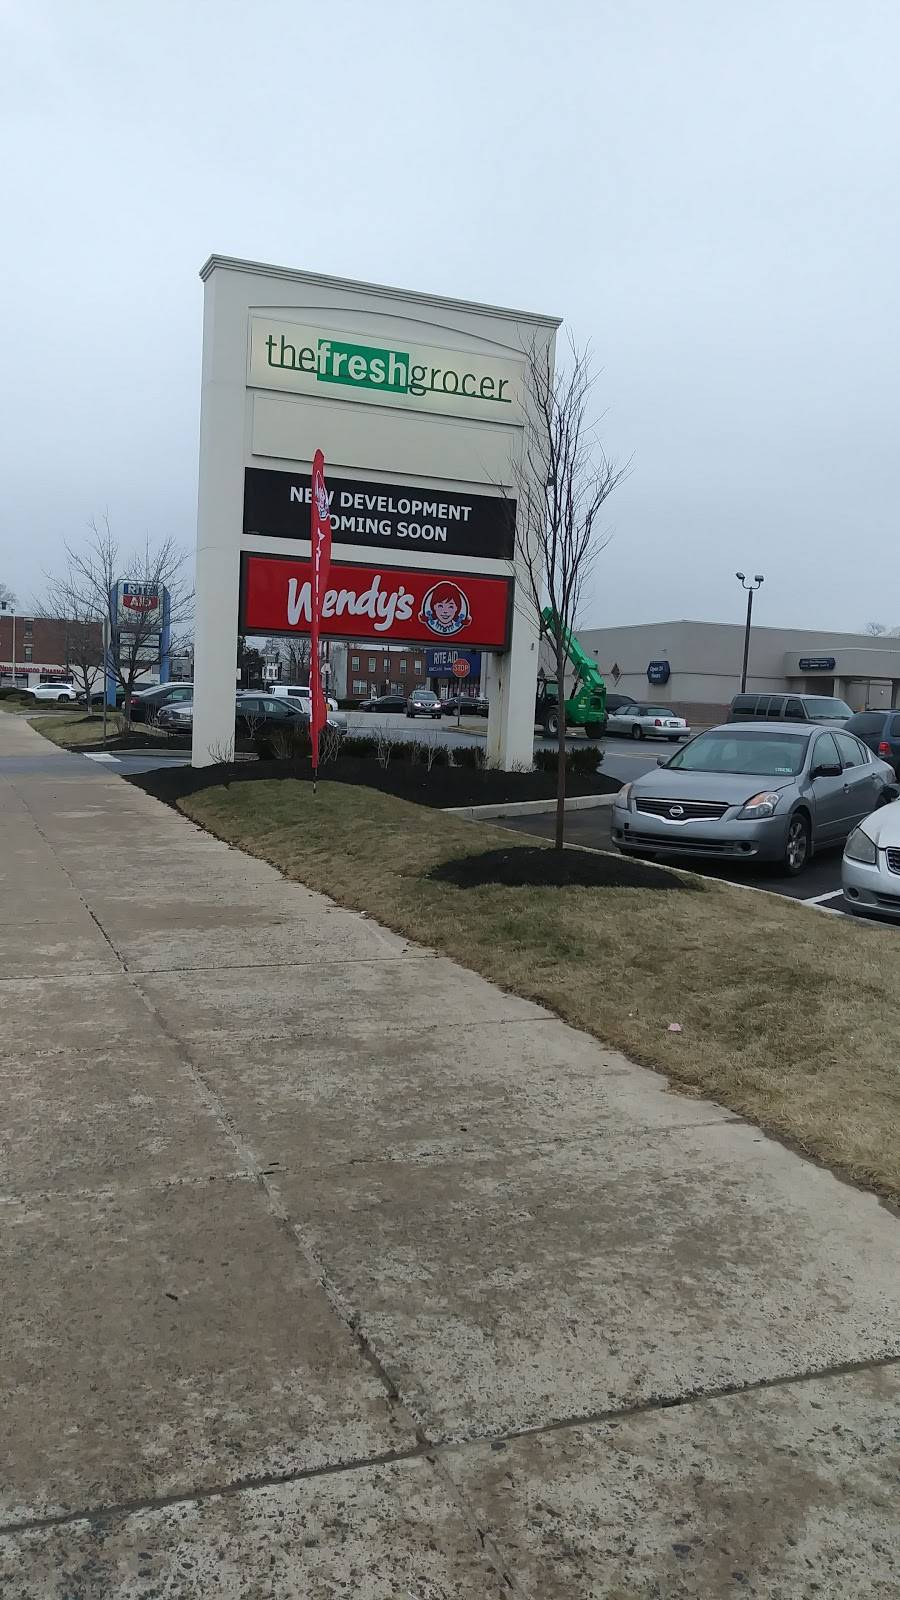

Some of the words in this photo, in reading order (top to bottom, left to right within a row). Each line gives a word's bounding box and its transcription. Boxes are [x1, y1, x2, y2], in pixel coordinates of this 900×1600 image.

[340, 491, 472, 521] DEVELOPMENT
[329, 514, 392, 536] OMING
[396, 521, 448, 542] SOON
[433, 652, 446, 664] RITE
[454, 664, 469, 672] STOP
